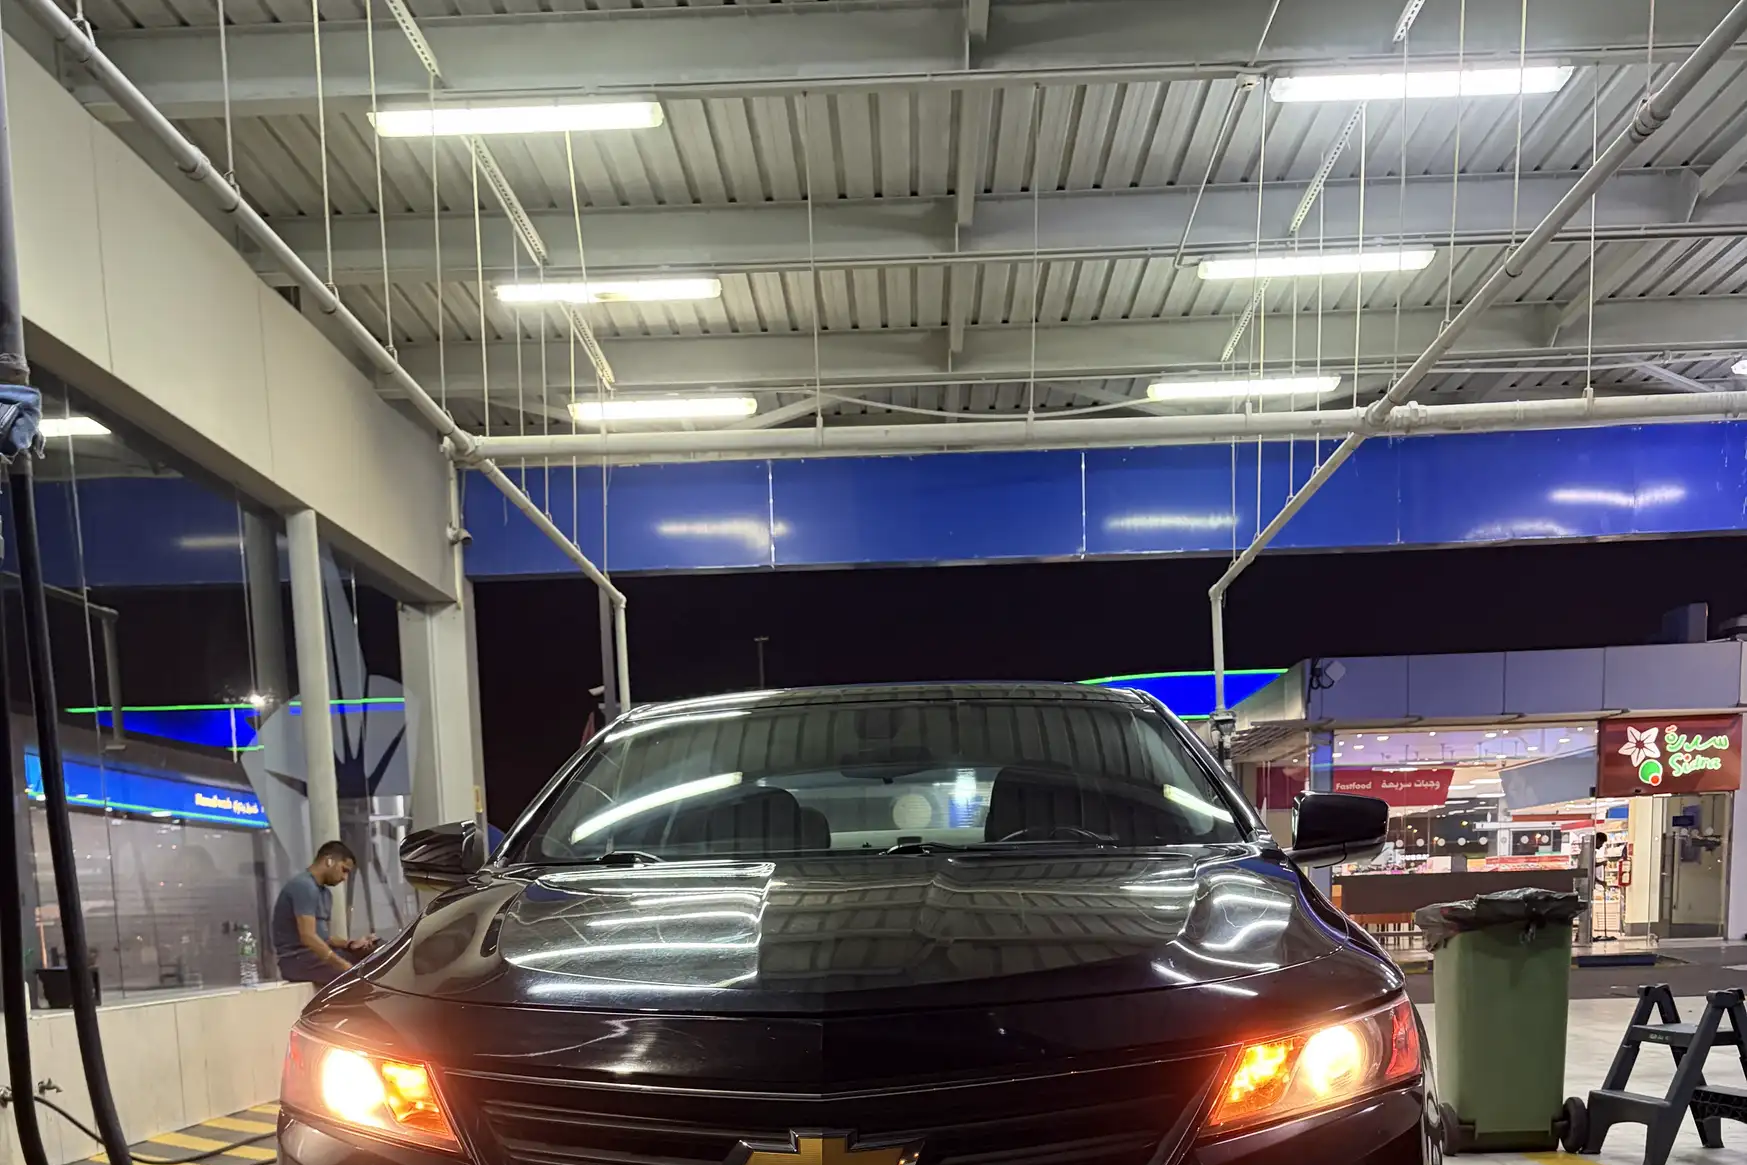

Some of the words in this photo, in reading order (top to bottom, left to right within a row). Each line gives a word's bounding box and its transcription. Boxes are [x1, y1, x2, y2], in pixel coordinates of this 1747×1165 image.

[1665, 725, 1729, 752] سدرة
[1669, 752, 1721, 777] Sidra
[1336, 782, 1372, 791] Fastfood
[1381, 780, 1412, 791] سريعة
[1414, 779, 1441, 790] وجبات
